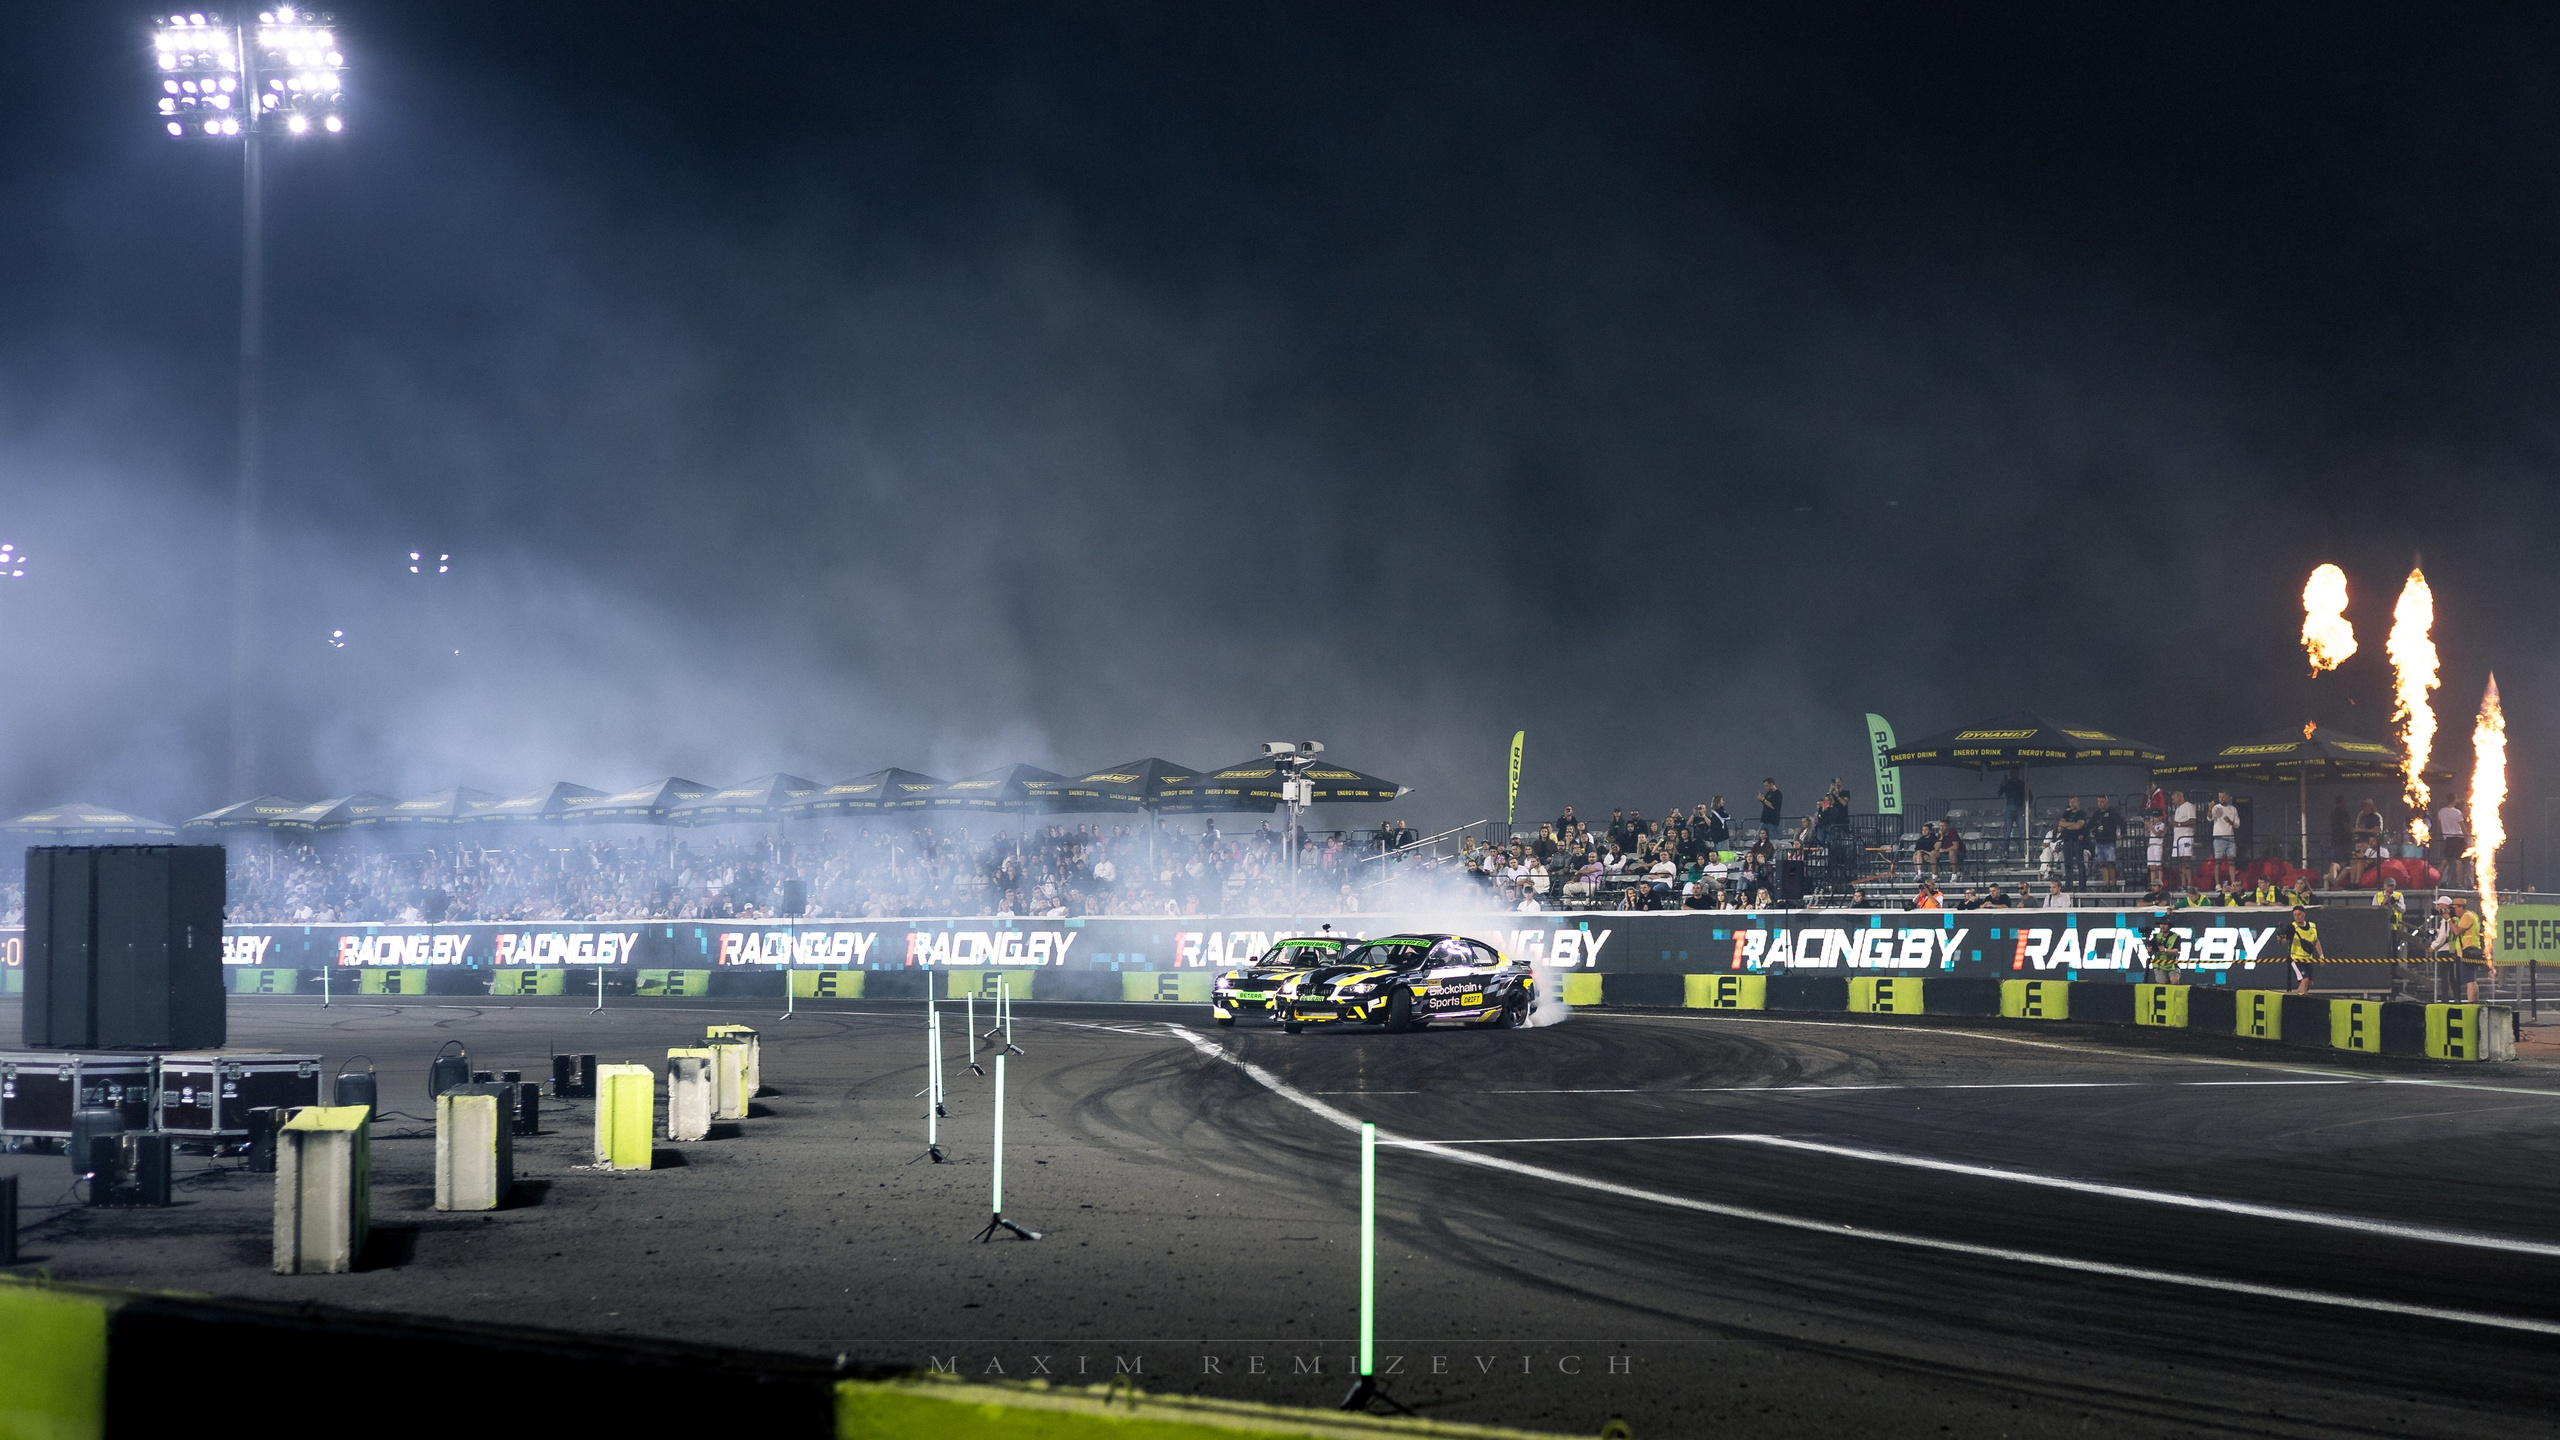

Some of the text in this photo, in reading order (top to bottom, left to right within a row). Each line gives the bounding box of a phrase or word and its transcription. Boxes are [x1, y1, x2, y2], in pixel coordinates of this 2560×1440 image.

[1891, 751, 1937, 761] ENERGY DRINK
[2018, 749, 2067, 758] ENERGY DRINK
[1429, 996, 1460, 1010] Sports
[1463, 996, 1480, 1004] DRIFT
